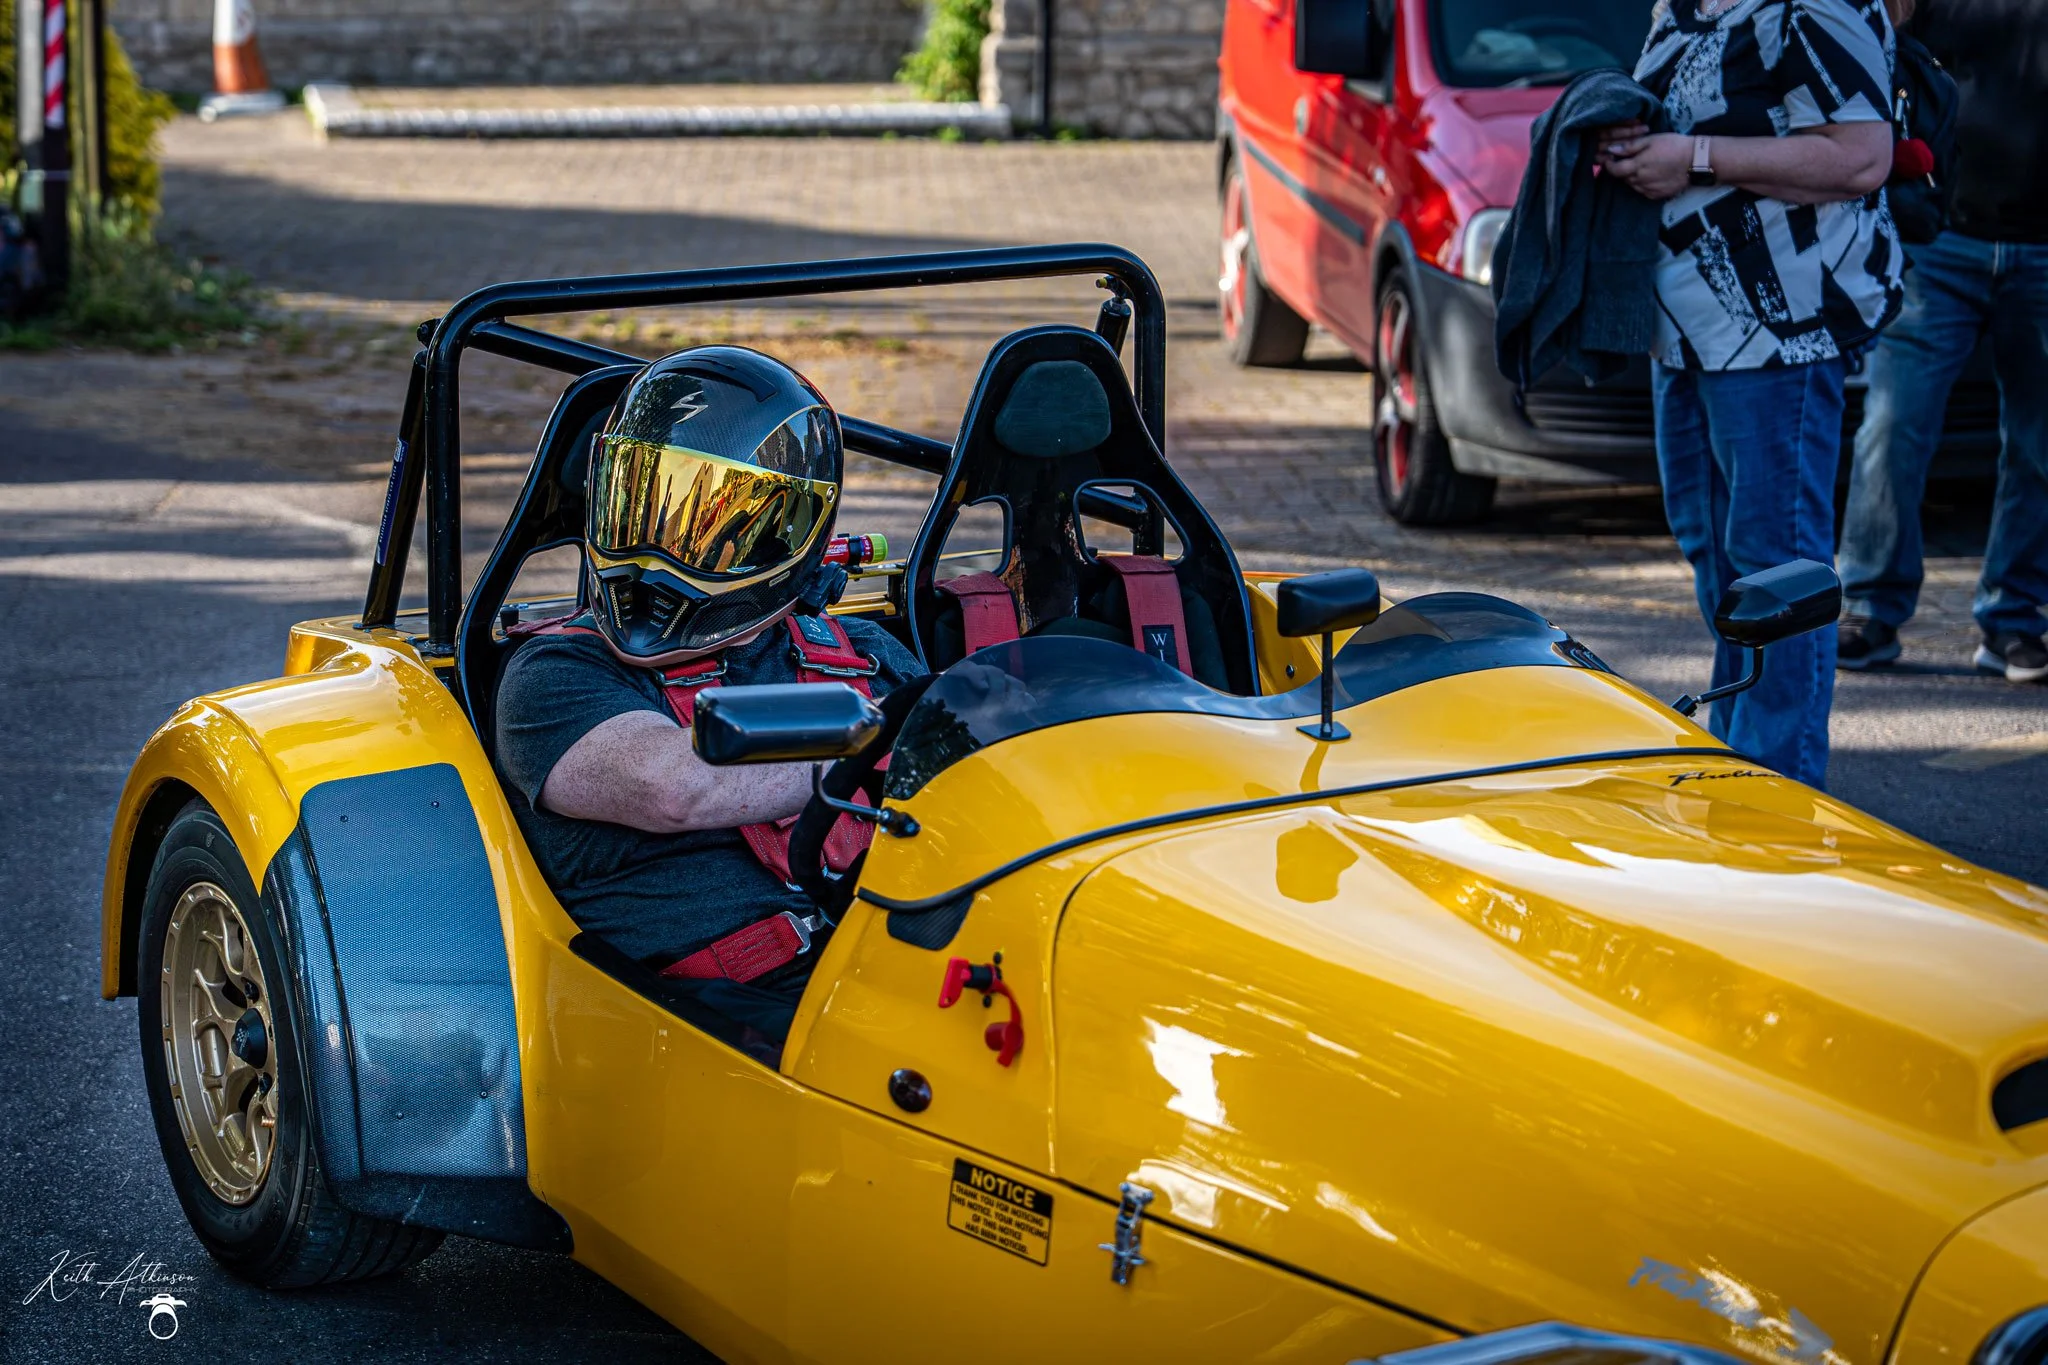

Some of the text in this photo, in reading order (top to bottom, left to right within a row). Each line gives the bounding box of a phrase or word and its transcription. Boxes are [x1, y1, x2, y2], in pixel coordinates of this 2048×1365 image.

[956, 1184, 1044, 1227] THANK YOU FOR NOTICING
[970, 1167, 1036, 1209] NOTICE
[952, 1193, 966, 1207] THIS
[994, 1211, 1013, 1226] YOUR
[1014, 1219, 1049, 1241] NOTICING
[965, 1222, 979, 1234] HAS
[980, 1228, 997, 1241] BEEN
[972, 1213, 1023, 1241] OF THIS NOTICE
